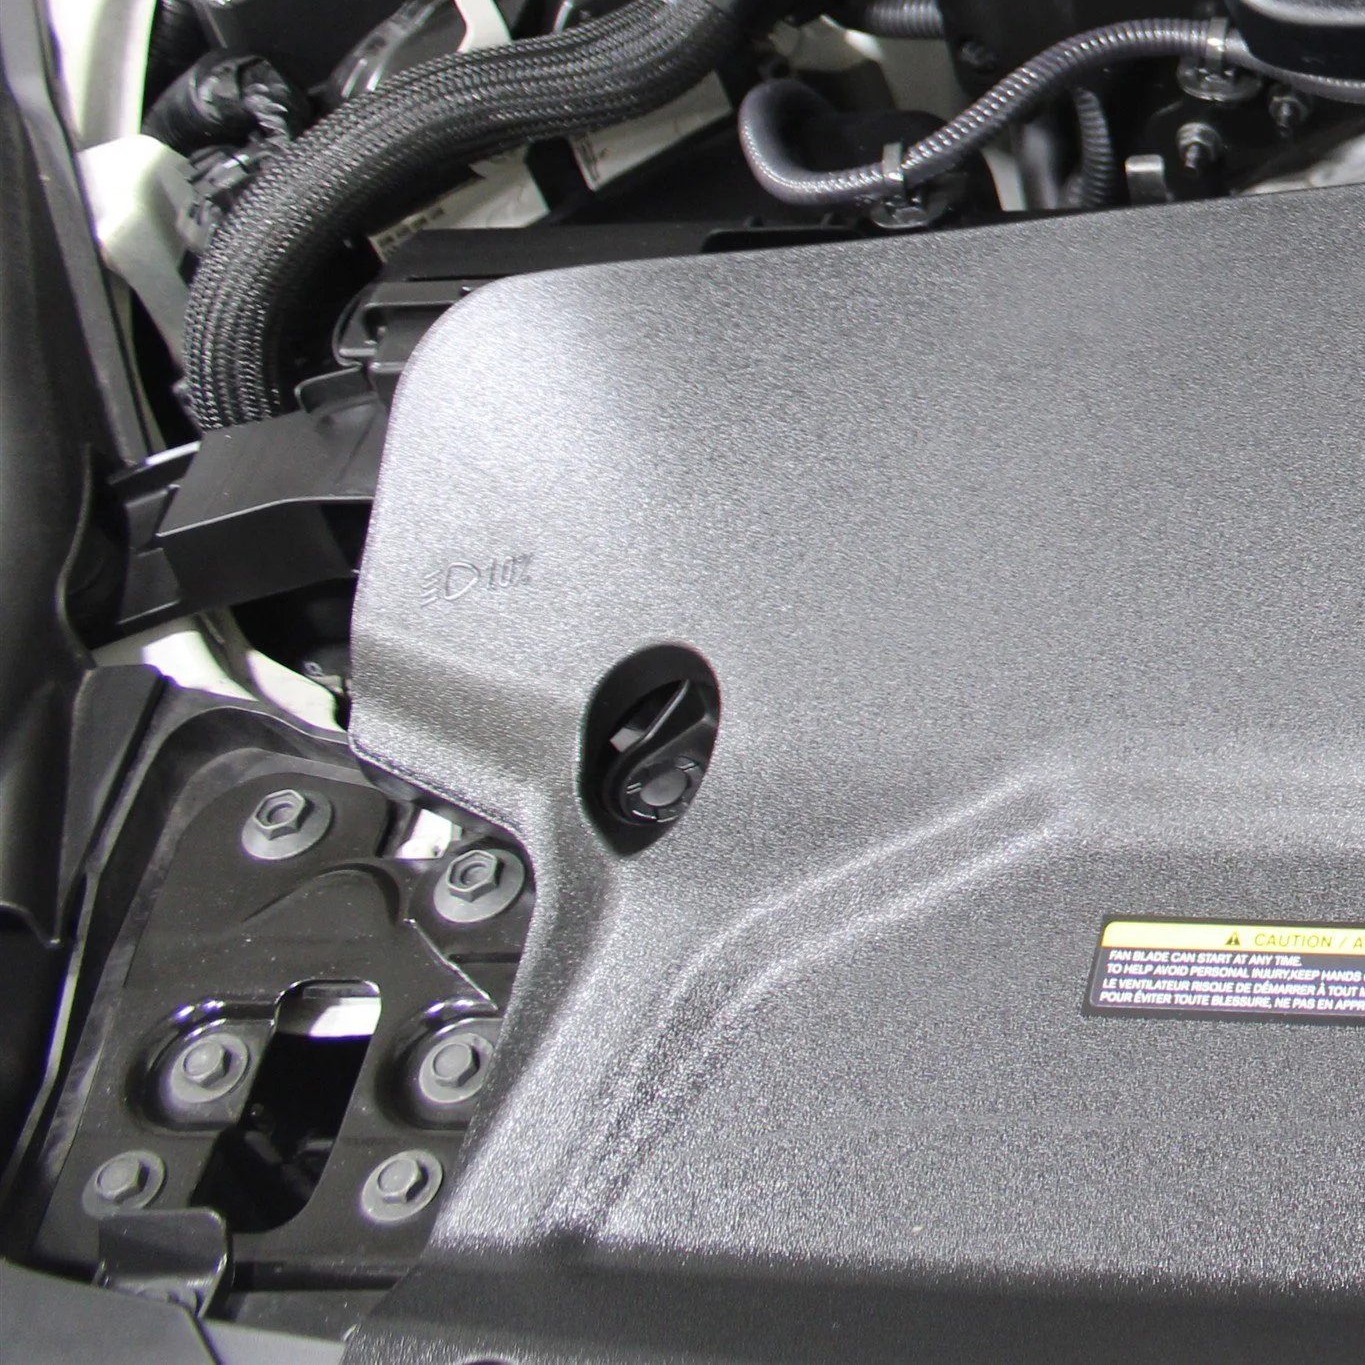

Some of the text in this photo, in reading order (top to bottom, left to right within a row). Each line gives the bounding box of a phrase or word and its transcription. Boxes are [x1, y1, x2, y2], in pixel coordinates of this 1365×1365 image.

[1254, 933, 1332, 948] CAUTION
[1109, 950, 1302, 966] FAN BLADE CAN START AT ANY TIME.
[1107, 964, 1122, 974] TO
[1123, 964, 1153, 975] HELP
[1153, 965, 1188, 976] AVOID
[1190, 966, 1249, 978] PERSONAL
[1321, 970, 1361, 983] HANDS
[1103, 978, 1118, 989] LE
[1119, 979, 1190, 992] VENTILATEUR
[1192, 981, 1233, 993] RISQUE
[1235, 983, 1251, 994] DE
[1253, 980, 1315, 996] DÉMARRER
[1329, 986, 1358, 997] TOUT
[1100, 992, 1132, 1003] POUR
[1134, 990, 1172, 1005] ÉVITER
[1174, 994, 1209, 1006] TOUTE
[1274, 997, 1291, 1009] NE
[1292, 998, 1316, 1009] PAS
[1318, 999, 1333, 1010] EN
